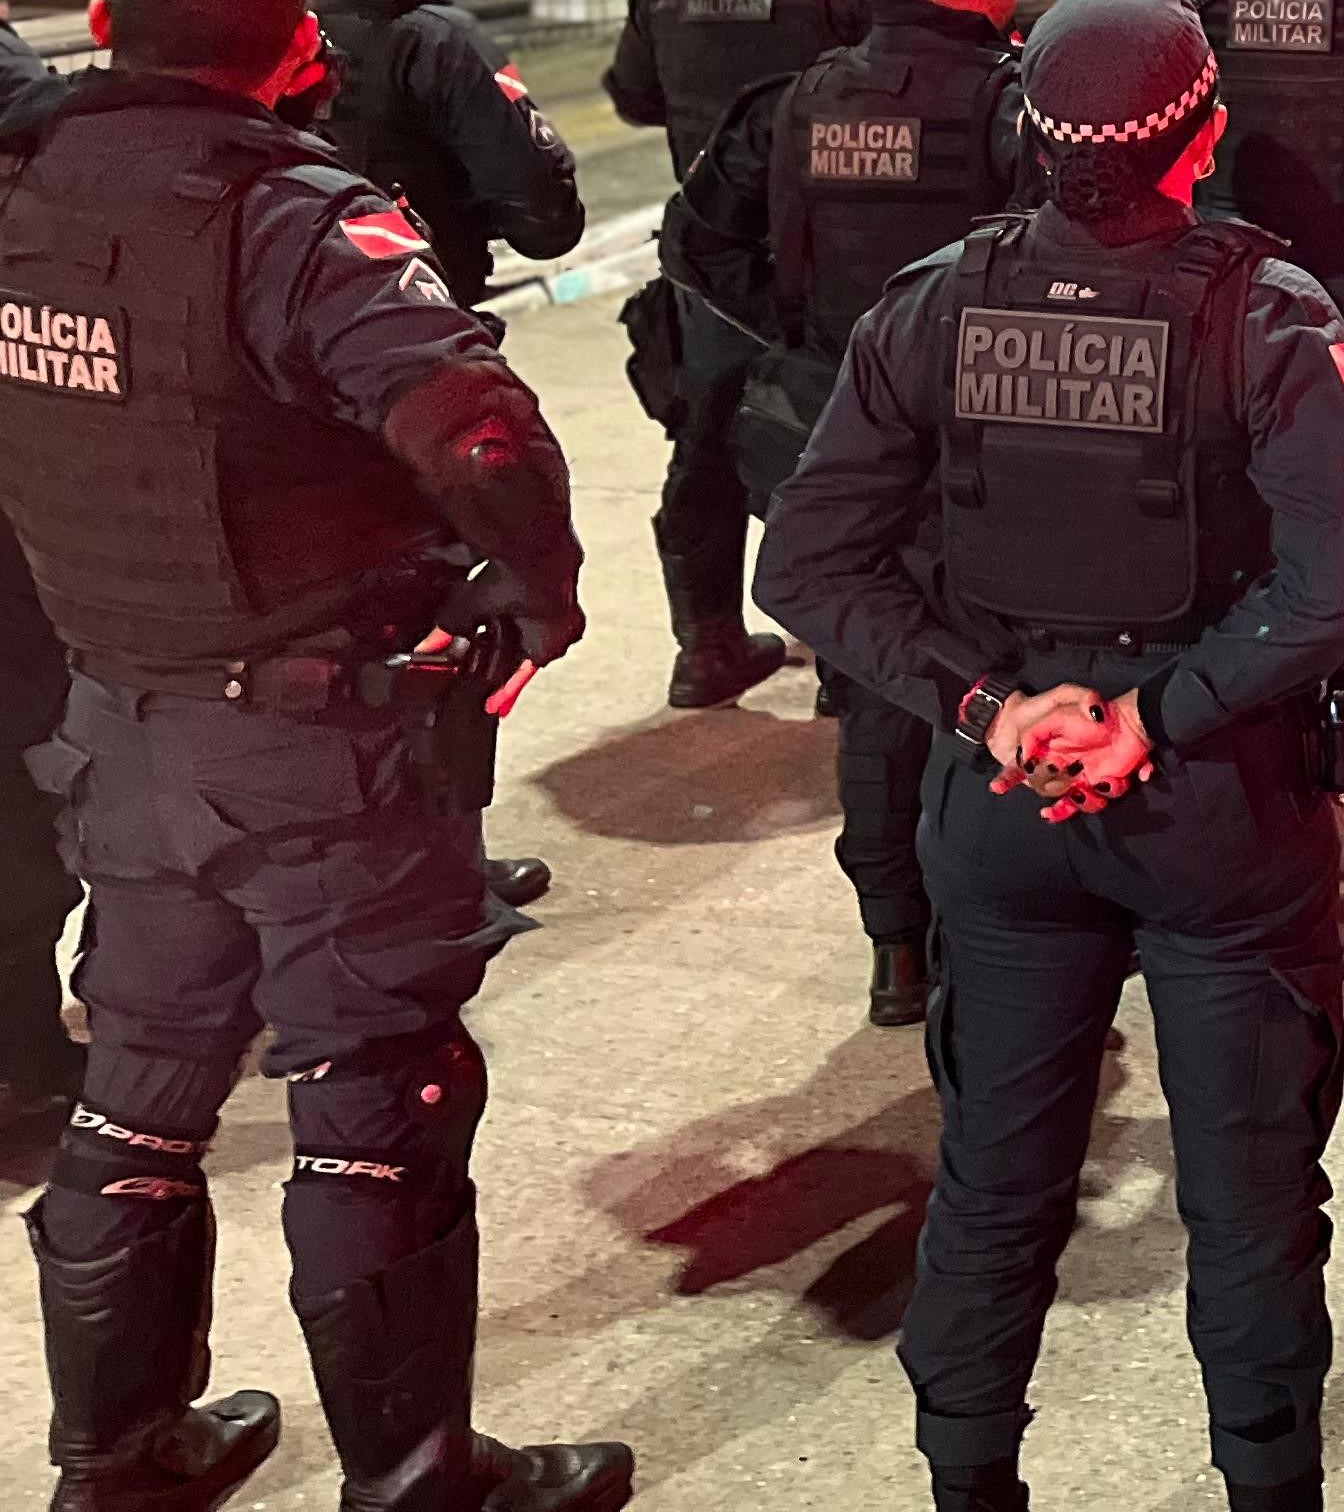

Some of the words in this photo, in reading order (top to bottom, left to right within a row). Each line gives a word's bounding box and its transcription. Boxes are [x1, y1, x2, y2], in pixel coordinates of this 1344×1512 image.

[1234, 23, 1322, 44] MILITAR
[811, 121, 913, 150] POLÍCIA
[811, 149, 913, 177] MILITAR
[0, 302, 117, 354] OLÍCIA
[963, 322, 1156, 378] POLÍCIA
[960, 371, 1154, 426] MILITAR
